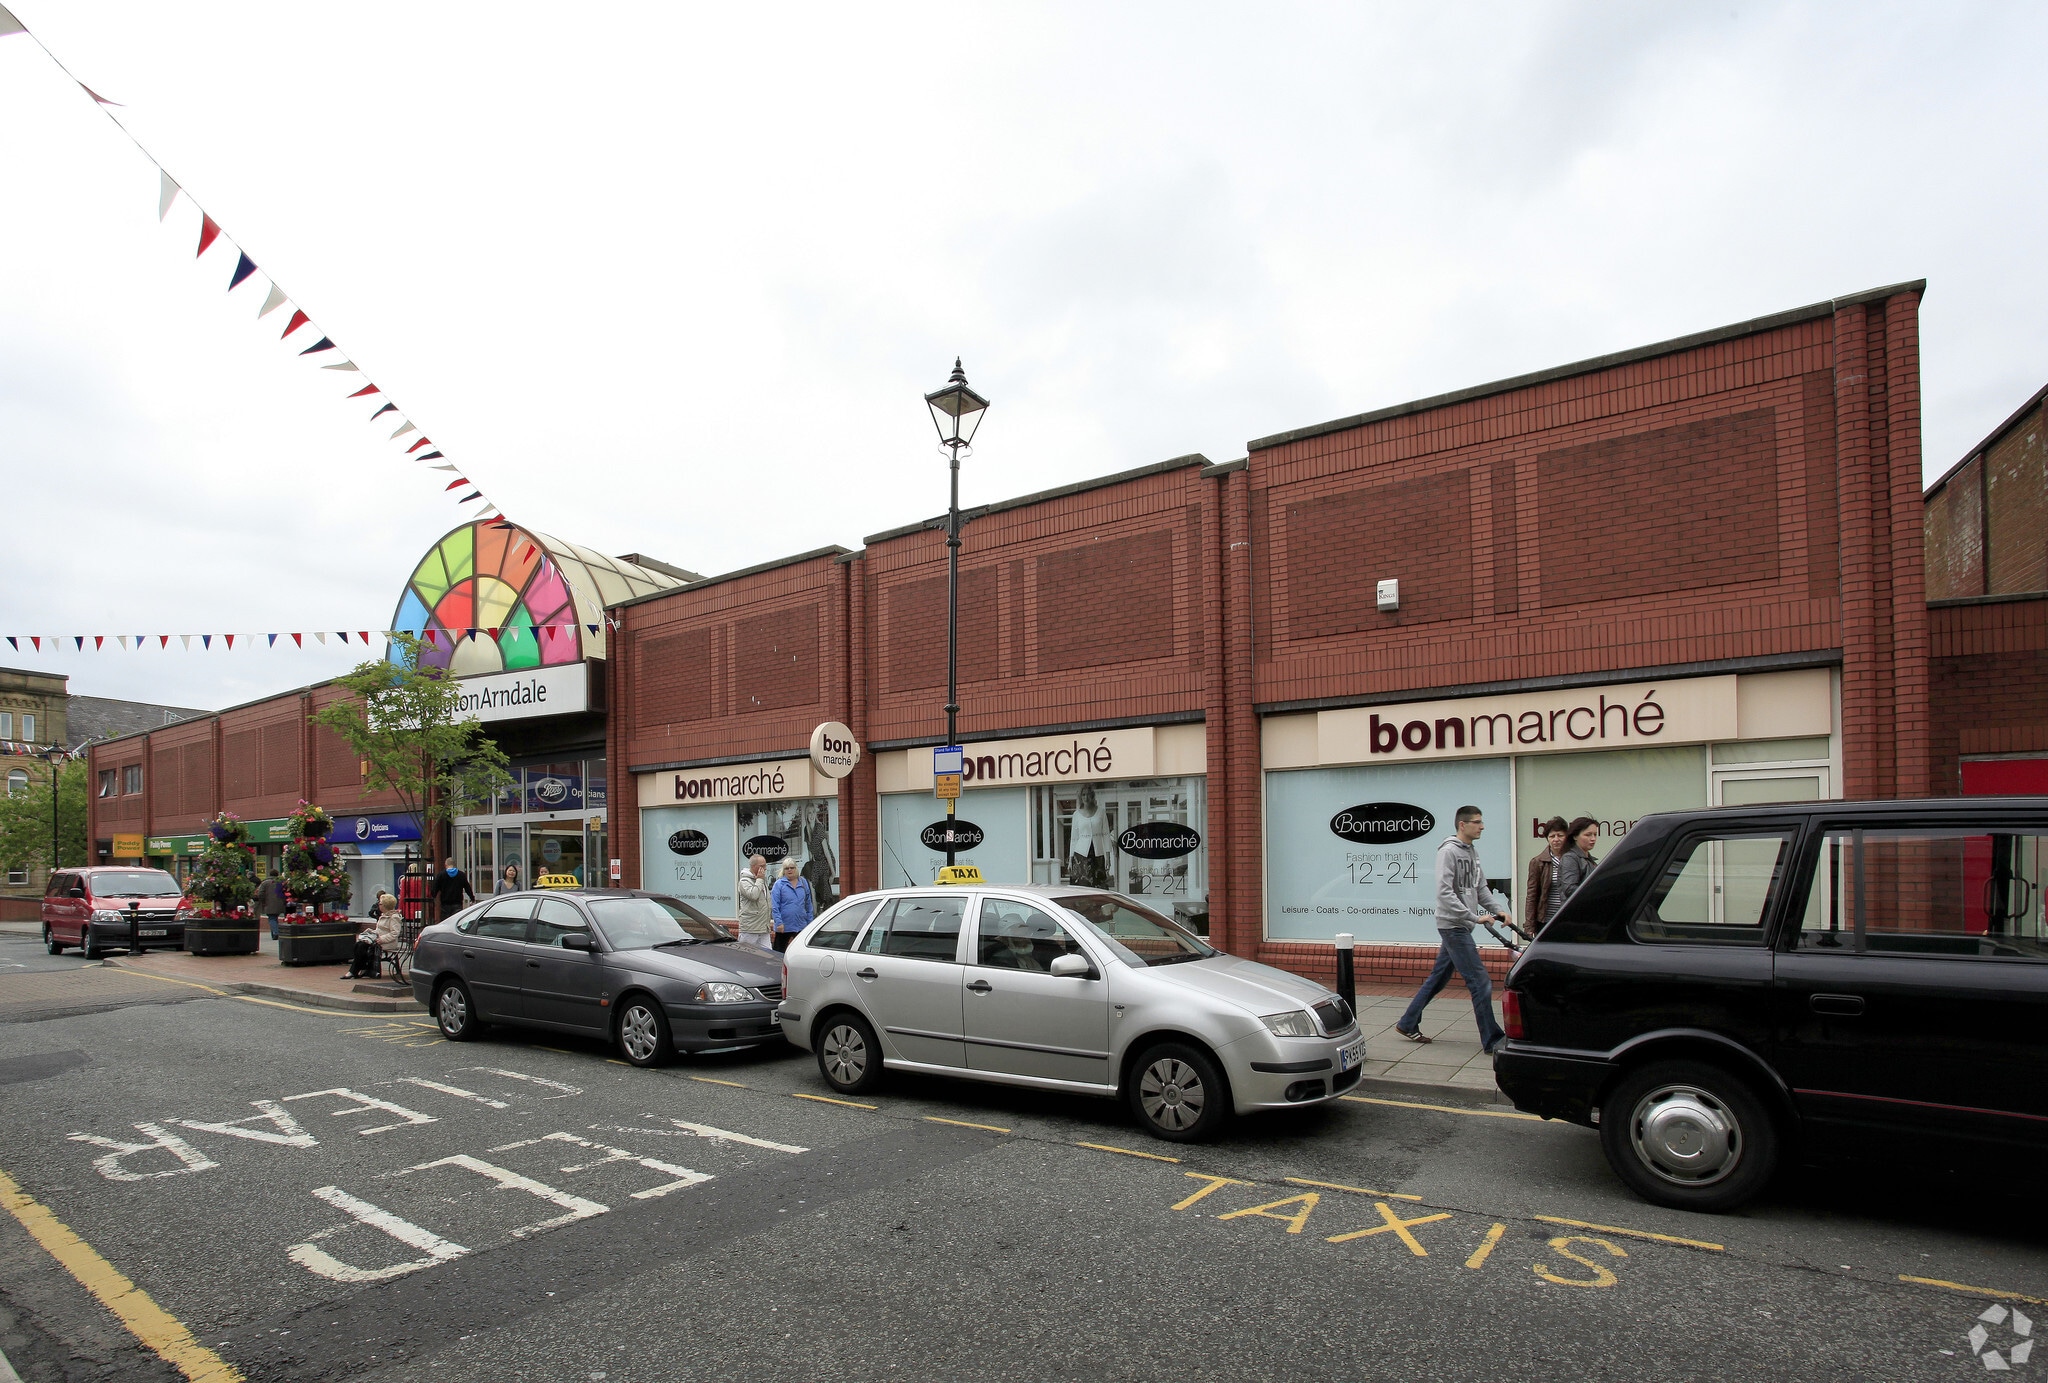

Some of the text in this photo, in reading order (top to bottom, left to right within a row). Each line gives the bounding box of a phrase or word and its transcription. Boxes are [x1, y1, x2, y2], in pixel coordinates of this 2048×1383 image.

[1369, 689, 1665, 753] bonmarché
[823, 734, 852, 754] bon
[823, 755, 852, 767] marché
[962, 737, 1112, 781] onmarché
[675, 766, 785, 800] bonmarché
[571, 788, 606, 799] Opcians
[1334, 812, 1431, 834] Bonmarché
[670, 835, 708, 850] Bonmarché
[923, 827, 982, 845] Bonarché
[1121, 830, 1197, 850] Bonmarché
[744, 841, 788, 856] Bonmarché
[1346, 851, 1419, 862] Fashion that fits
[546, 876, 575, 884] TAXI
[675, 866, 703, 881] 12-24
[951, 868, 979, 879] TAXI
[1346, 861, 1419, 884] 12-24
[1281, 905, 1309, 914] Leisure
[1316, 905, 1339, 914] Coats
[1346, 905, 1399, 915] Co-ordinates
[1171, 1171, 1629, 1288] TAXIS
